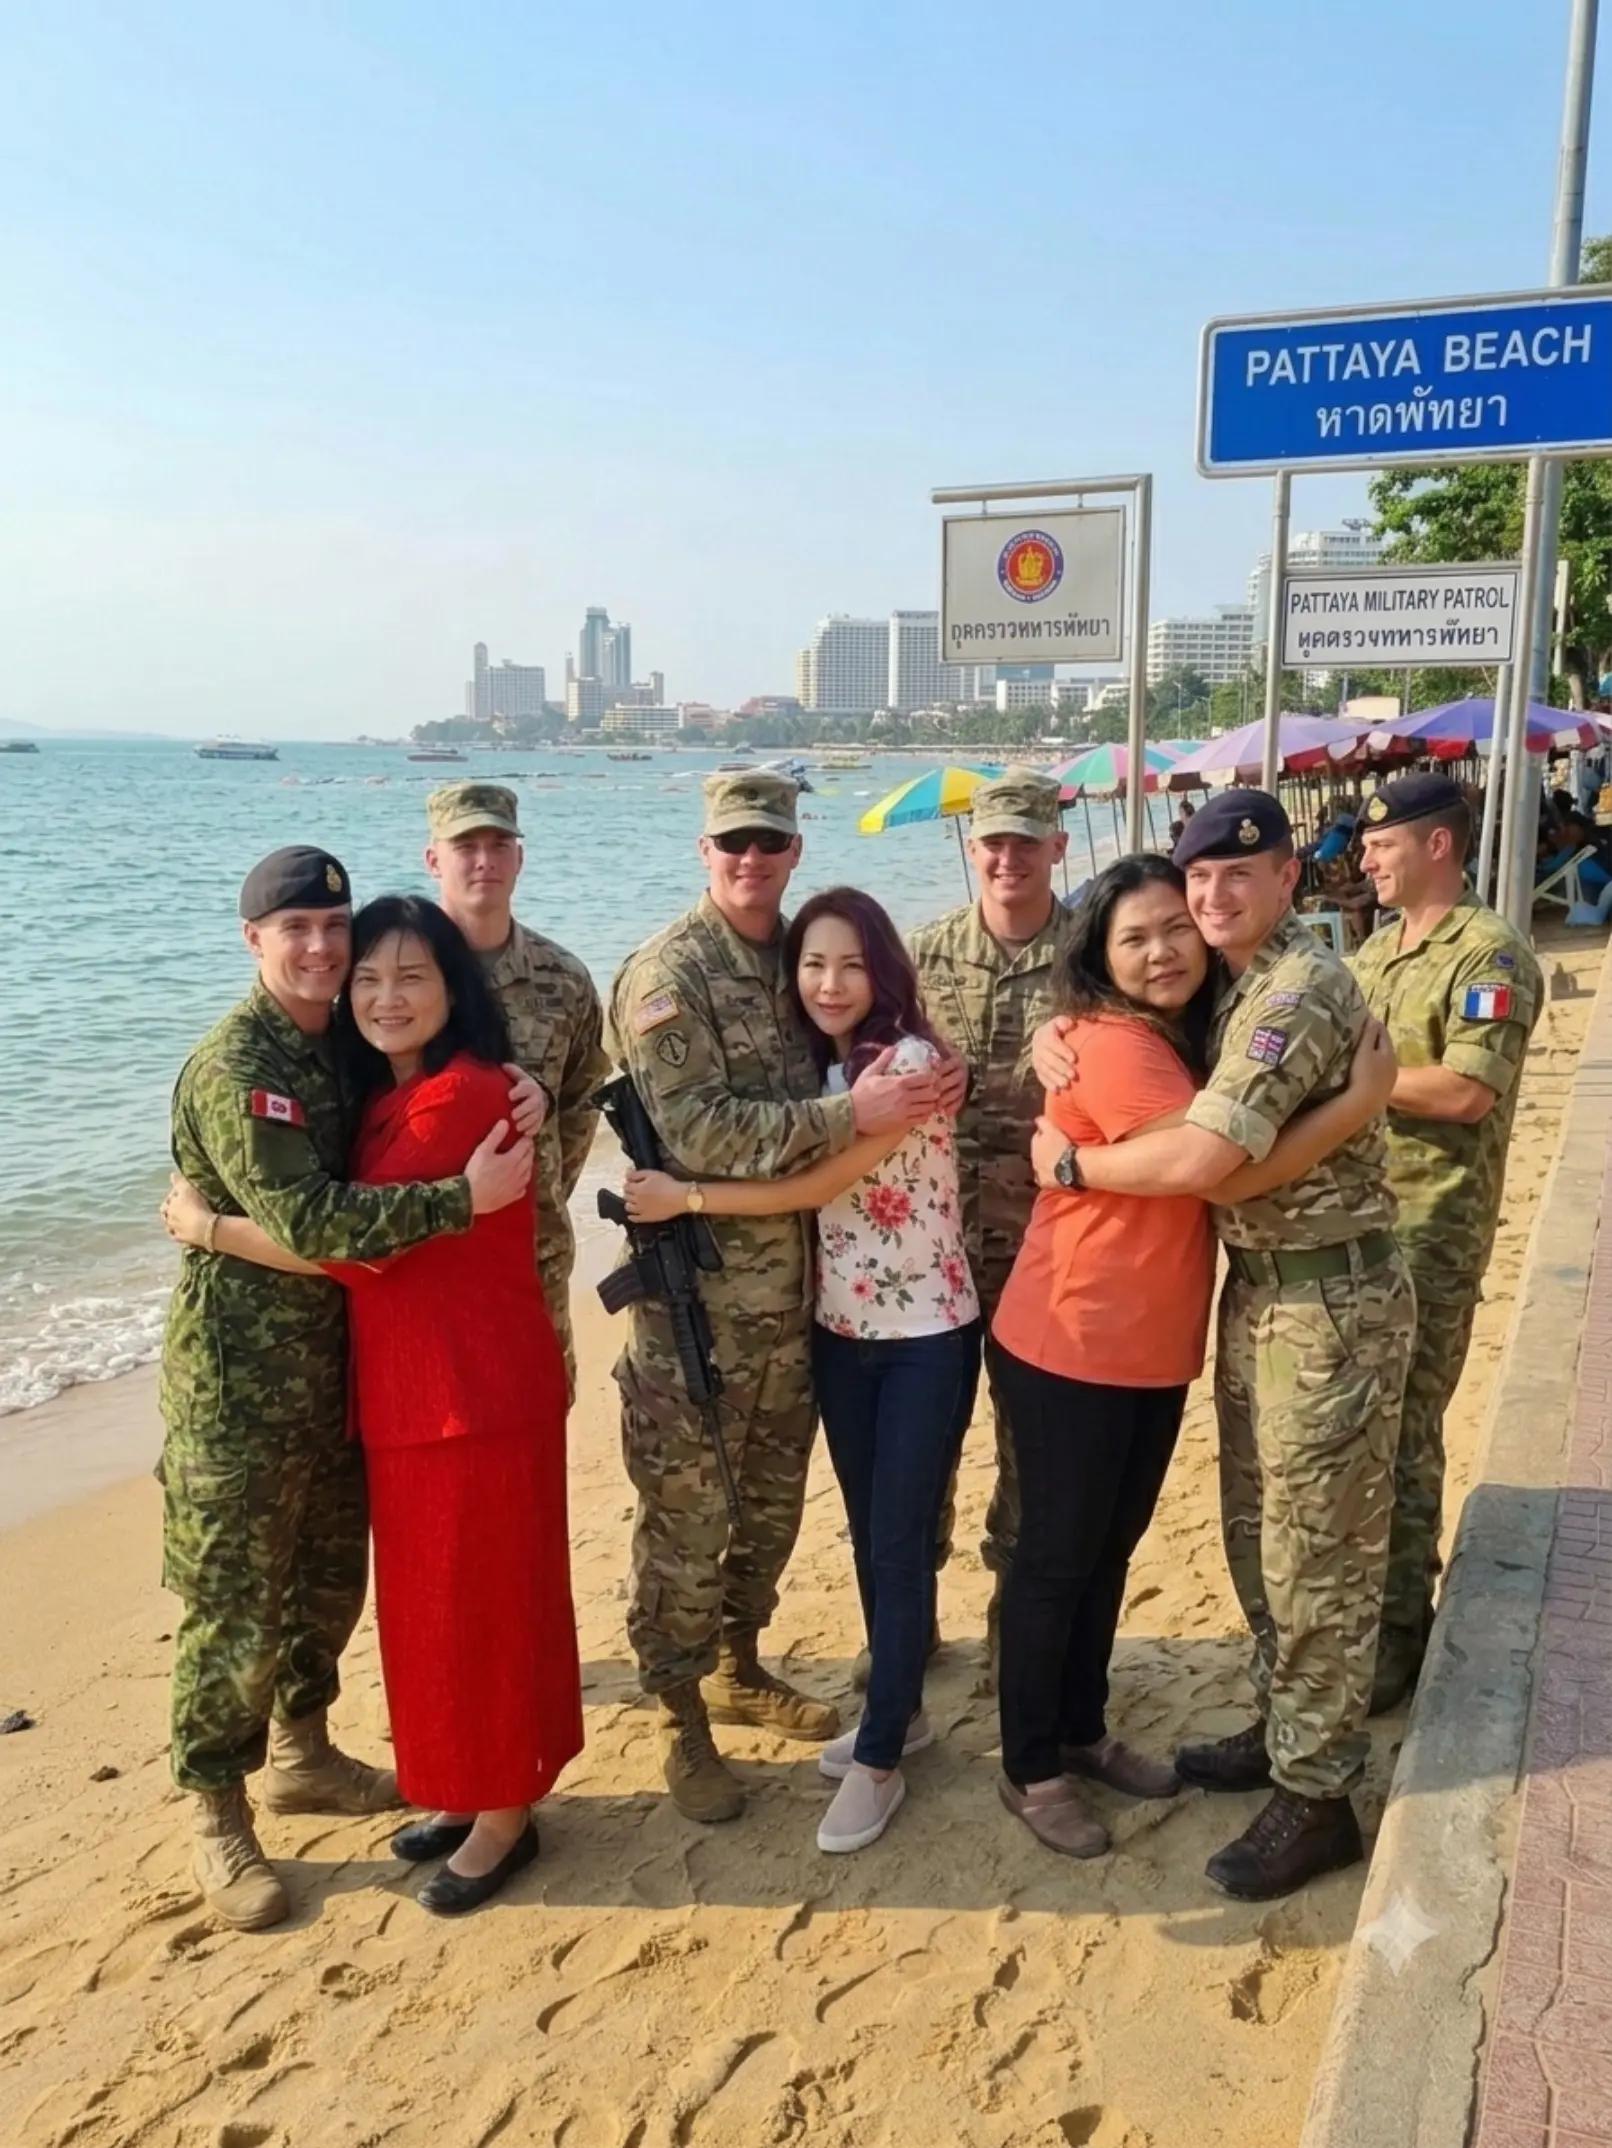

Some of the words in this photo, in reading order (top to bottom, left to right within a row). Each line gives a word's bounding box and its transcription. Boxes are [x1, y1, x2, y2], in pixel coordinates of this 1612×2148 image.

[1246, 338, 1421, 387] PATTAYA
[1443, 324, 1592, 373] BEACH
[1316, 385, 1508, 438] หาดพัทยา
[1291, 591, 1360, 614] PATTAYA
[1364, 588, 1440, 612] MILITARY
[1443, 586, 1509, 609] PATROL
